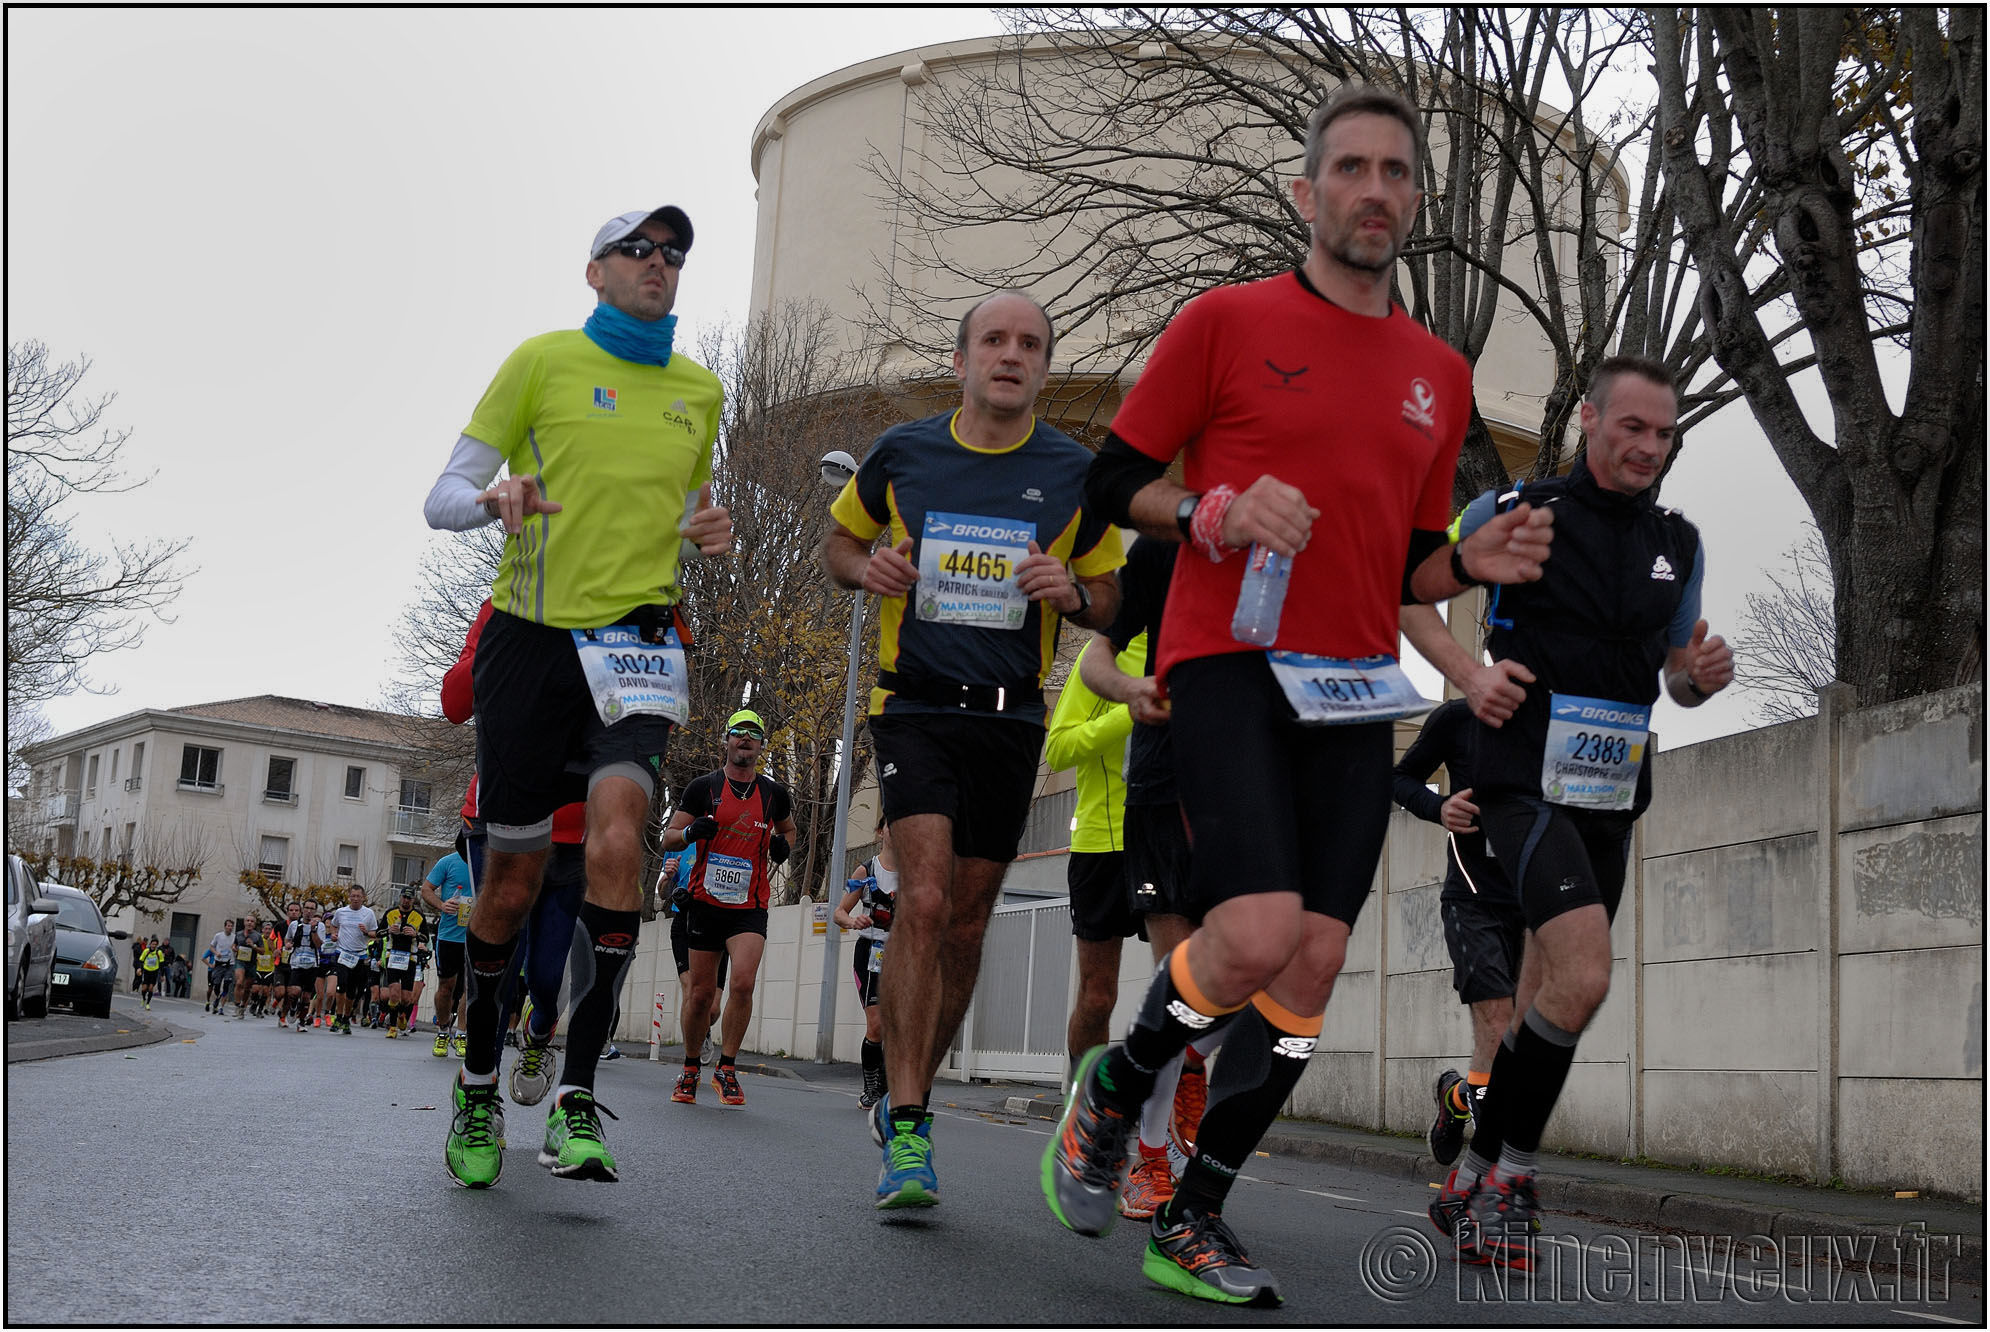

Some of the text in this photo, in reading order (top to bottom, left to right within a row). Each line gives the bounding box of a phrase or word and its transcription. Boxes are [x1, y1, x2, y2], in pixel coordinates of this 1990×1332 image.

[952, 524, 1031, 542] BROOKS
[945, 549, 1007, 582] 4465
[938, 580, 978, 596] PATRICK
[940, 601, 1001, 612] MARATHON
[608, 652, 670, 677] 3022
[619, 677, 648, 689] DAVID
[1312, 677, 1377, 702] 1877
[623, 693, 676, 705] MARATHON
[1581, 706, 1645, 726] BROOKS
[1572, 732, 1626, 766] 2383
[718, 859, 751, 868] BROOKS
[715, 868, 741, 885] 5860
